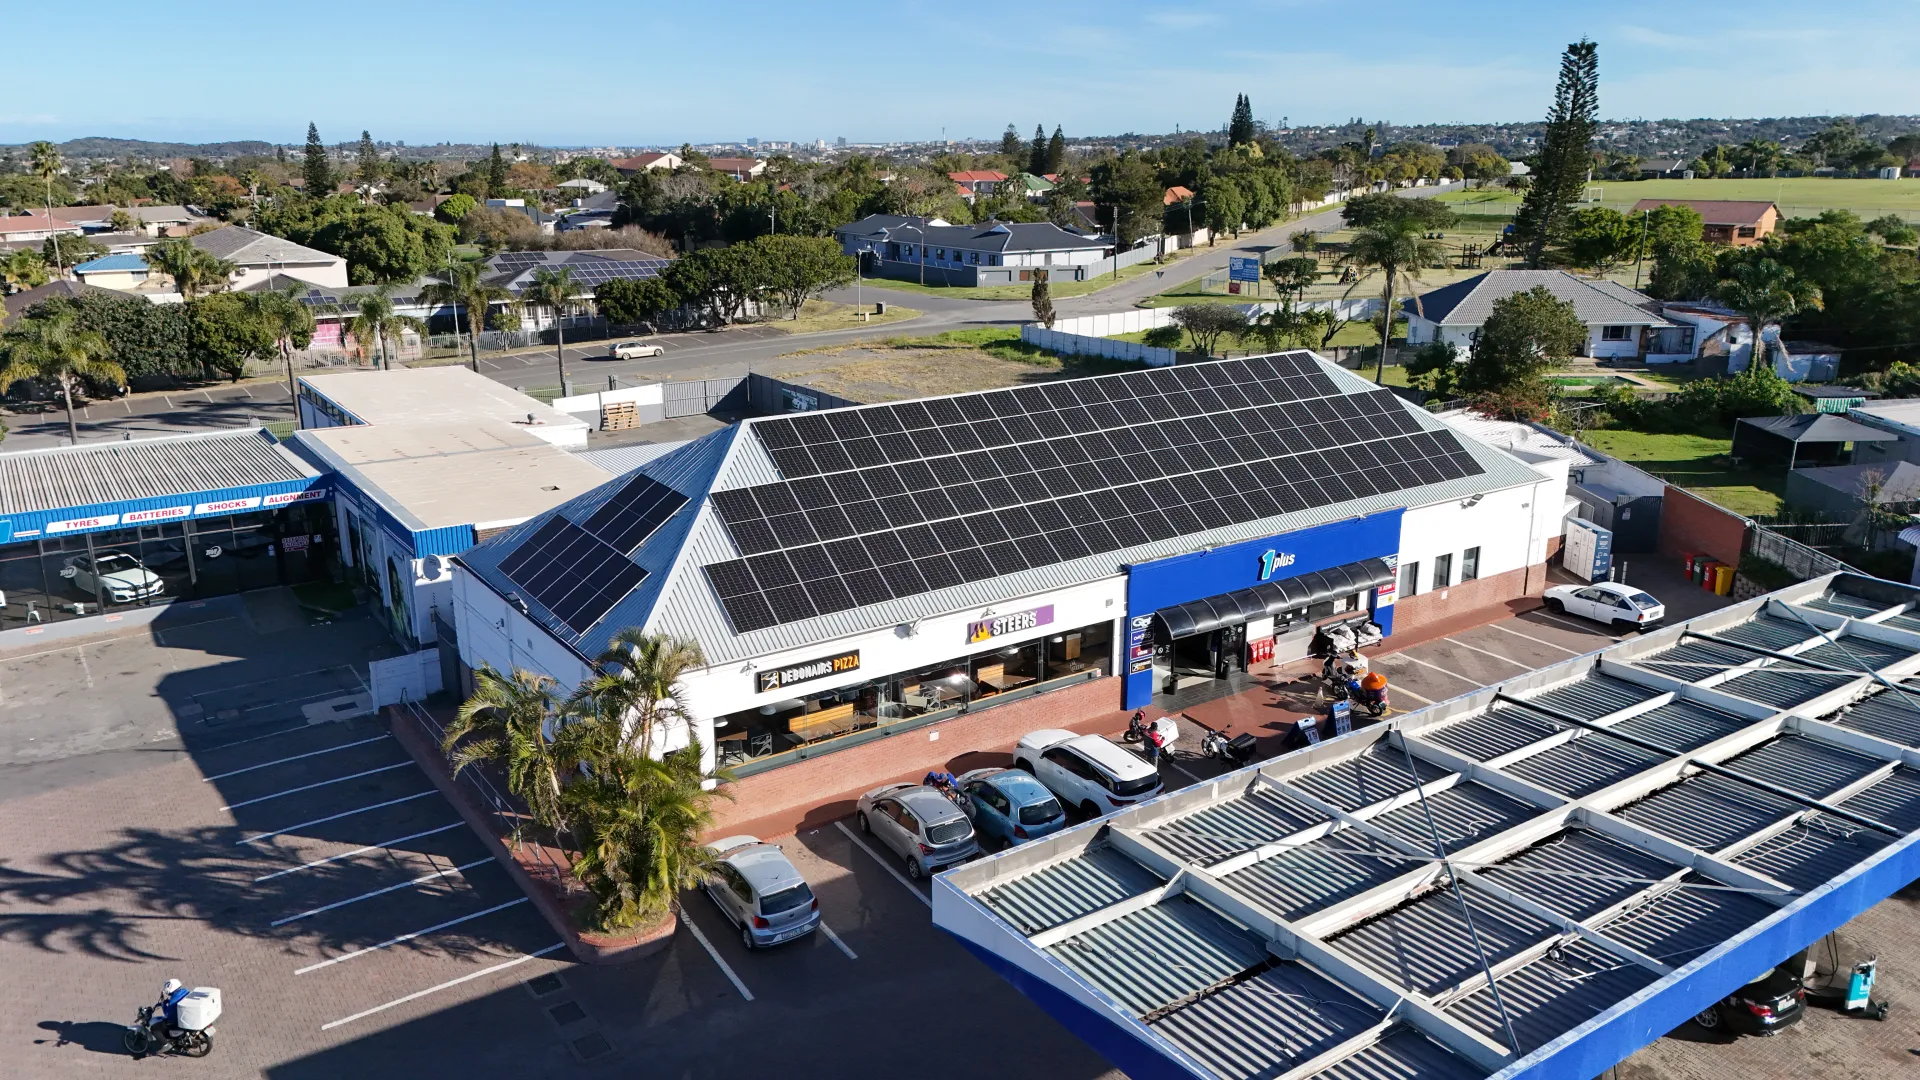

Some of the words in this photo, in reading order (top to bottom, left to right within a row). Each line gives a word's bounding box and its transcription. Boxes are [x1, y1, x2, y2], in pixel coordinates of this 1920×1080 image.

[268, 491, 321, 503] ALIGNMENT
[207, 500, 247, 511] SHOCKS
[129, 508, 184, 521] BATTERIES
[65, 519, 99, 529] TYRES
[993, 612, 1037, 636] STEERS
[781, 661, 833, 684] DEBONAIRS
[833, 654, 860, 671] PIZZA
